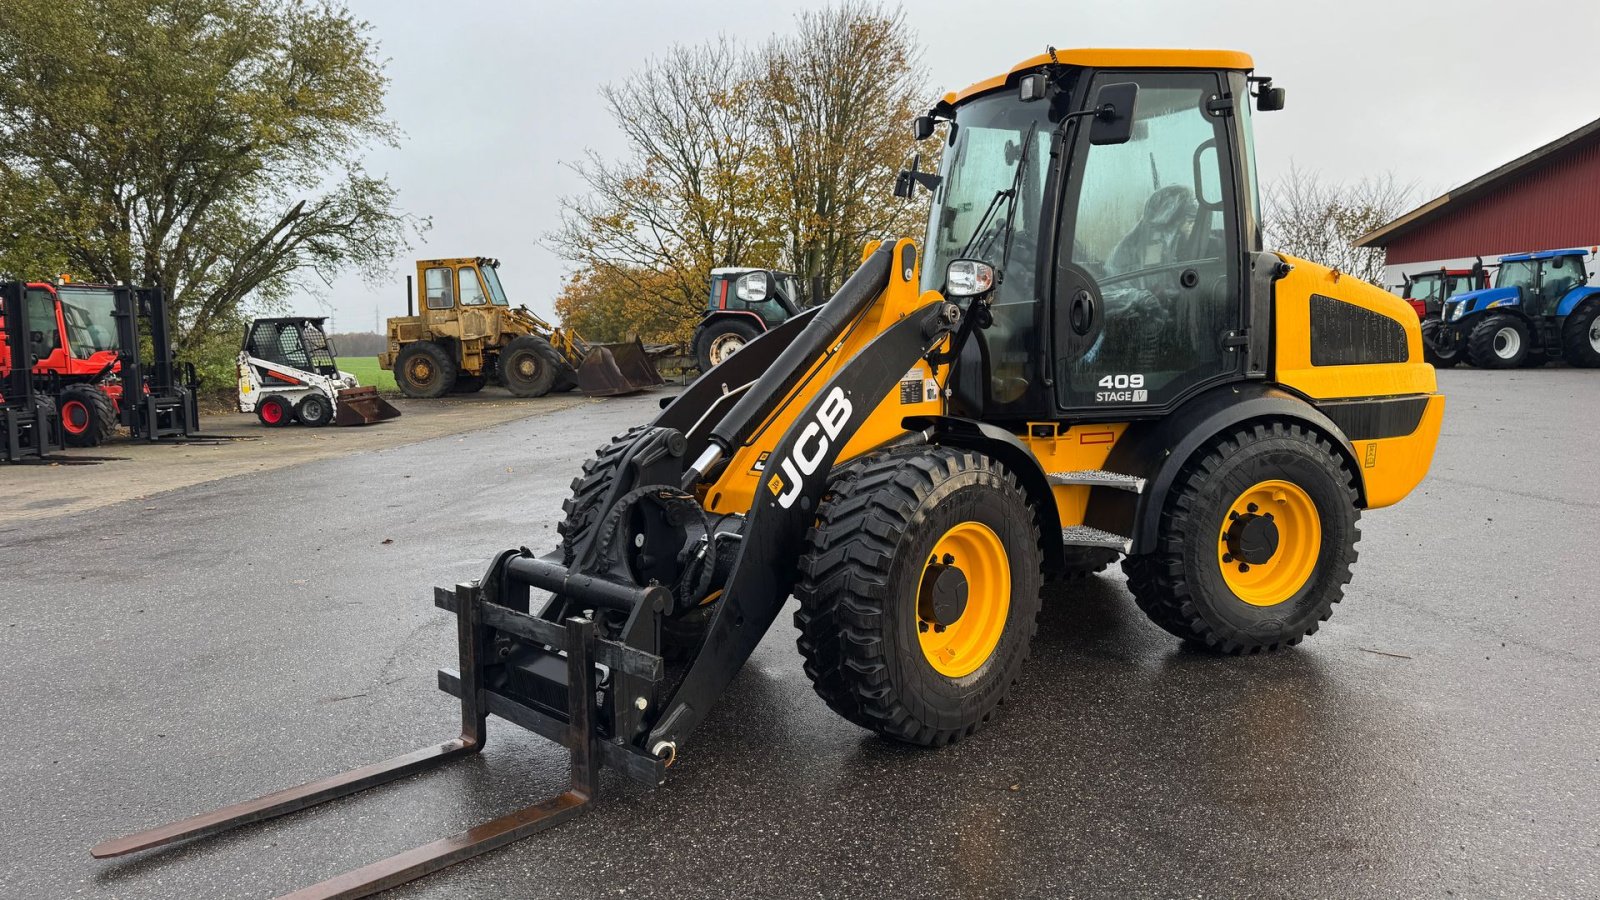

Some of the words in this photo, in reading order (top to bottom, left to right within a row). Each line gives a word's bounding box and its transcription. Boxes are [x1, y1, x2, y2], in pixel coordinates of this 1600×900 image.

[1098, 374, 1144, 389] 409
[1096, 391, 1132, 402] STAGE
[777, 386, 853, 509] JCB
